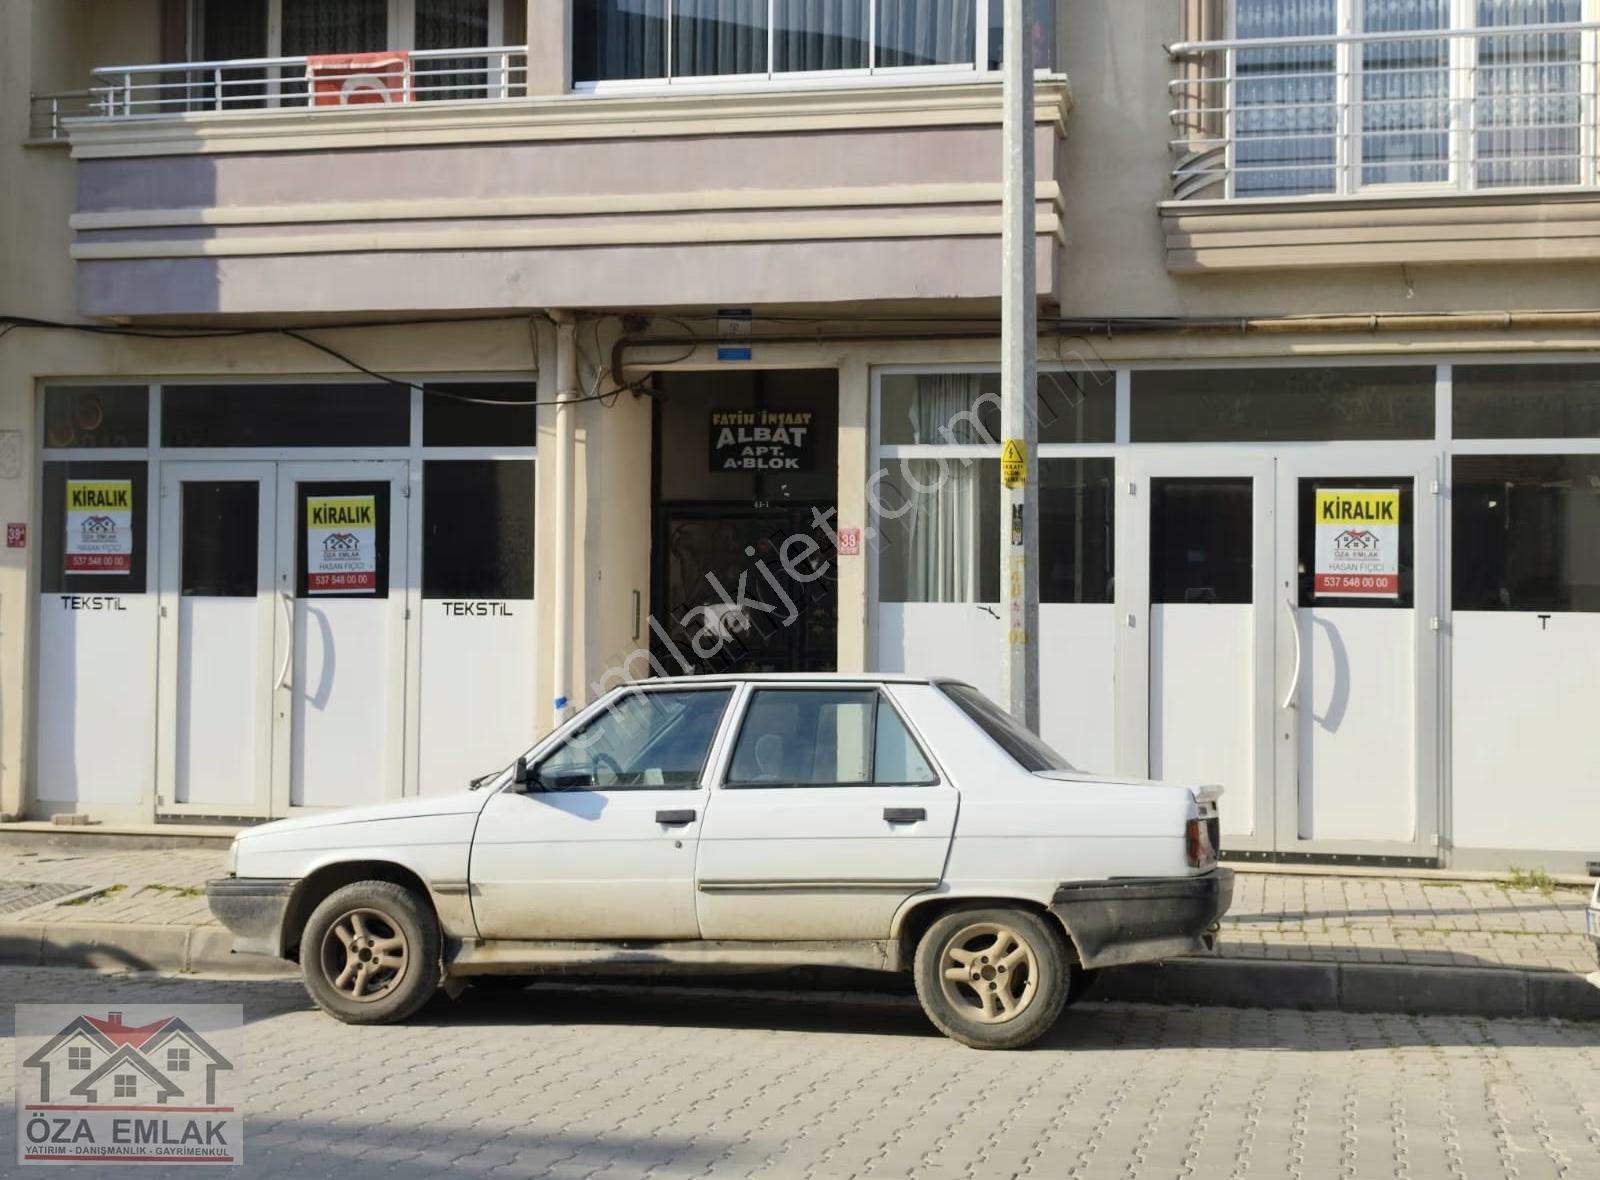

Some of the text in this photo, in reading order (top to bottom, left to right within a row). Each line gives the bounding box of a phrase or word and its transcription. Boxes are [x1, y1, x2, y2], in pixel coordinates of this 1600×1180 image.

[716, 427, 808, 449] ALBAT
[741, 446, 785, 456] APT.
[73, 485, 128, 507] KİRALIK
[313, 503, 371, 524] KİRALIK
[1322, 496, 1393, 520] KİRALIK
[104, 556, 113, 566] 00
[115, 556, 124, 566] 00
[1328, 563, 1358, 571] HASAN
[315, 575, 329, 585] 537
[347, 575, 356, 584] 00
[358, 574, 368, 584] 00
[1324, 577, 1340, 587] 537
[1362, 577, 1374, 587] 00
[1376, 578, 1388, 588] 00
[1537, 614, 1551, 631] T
